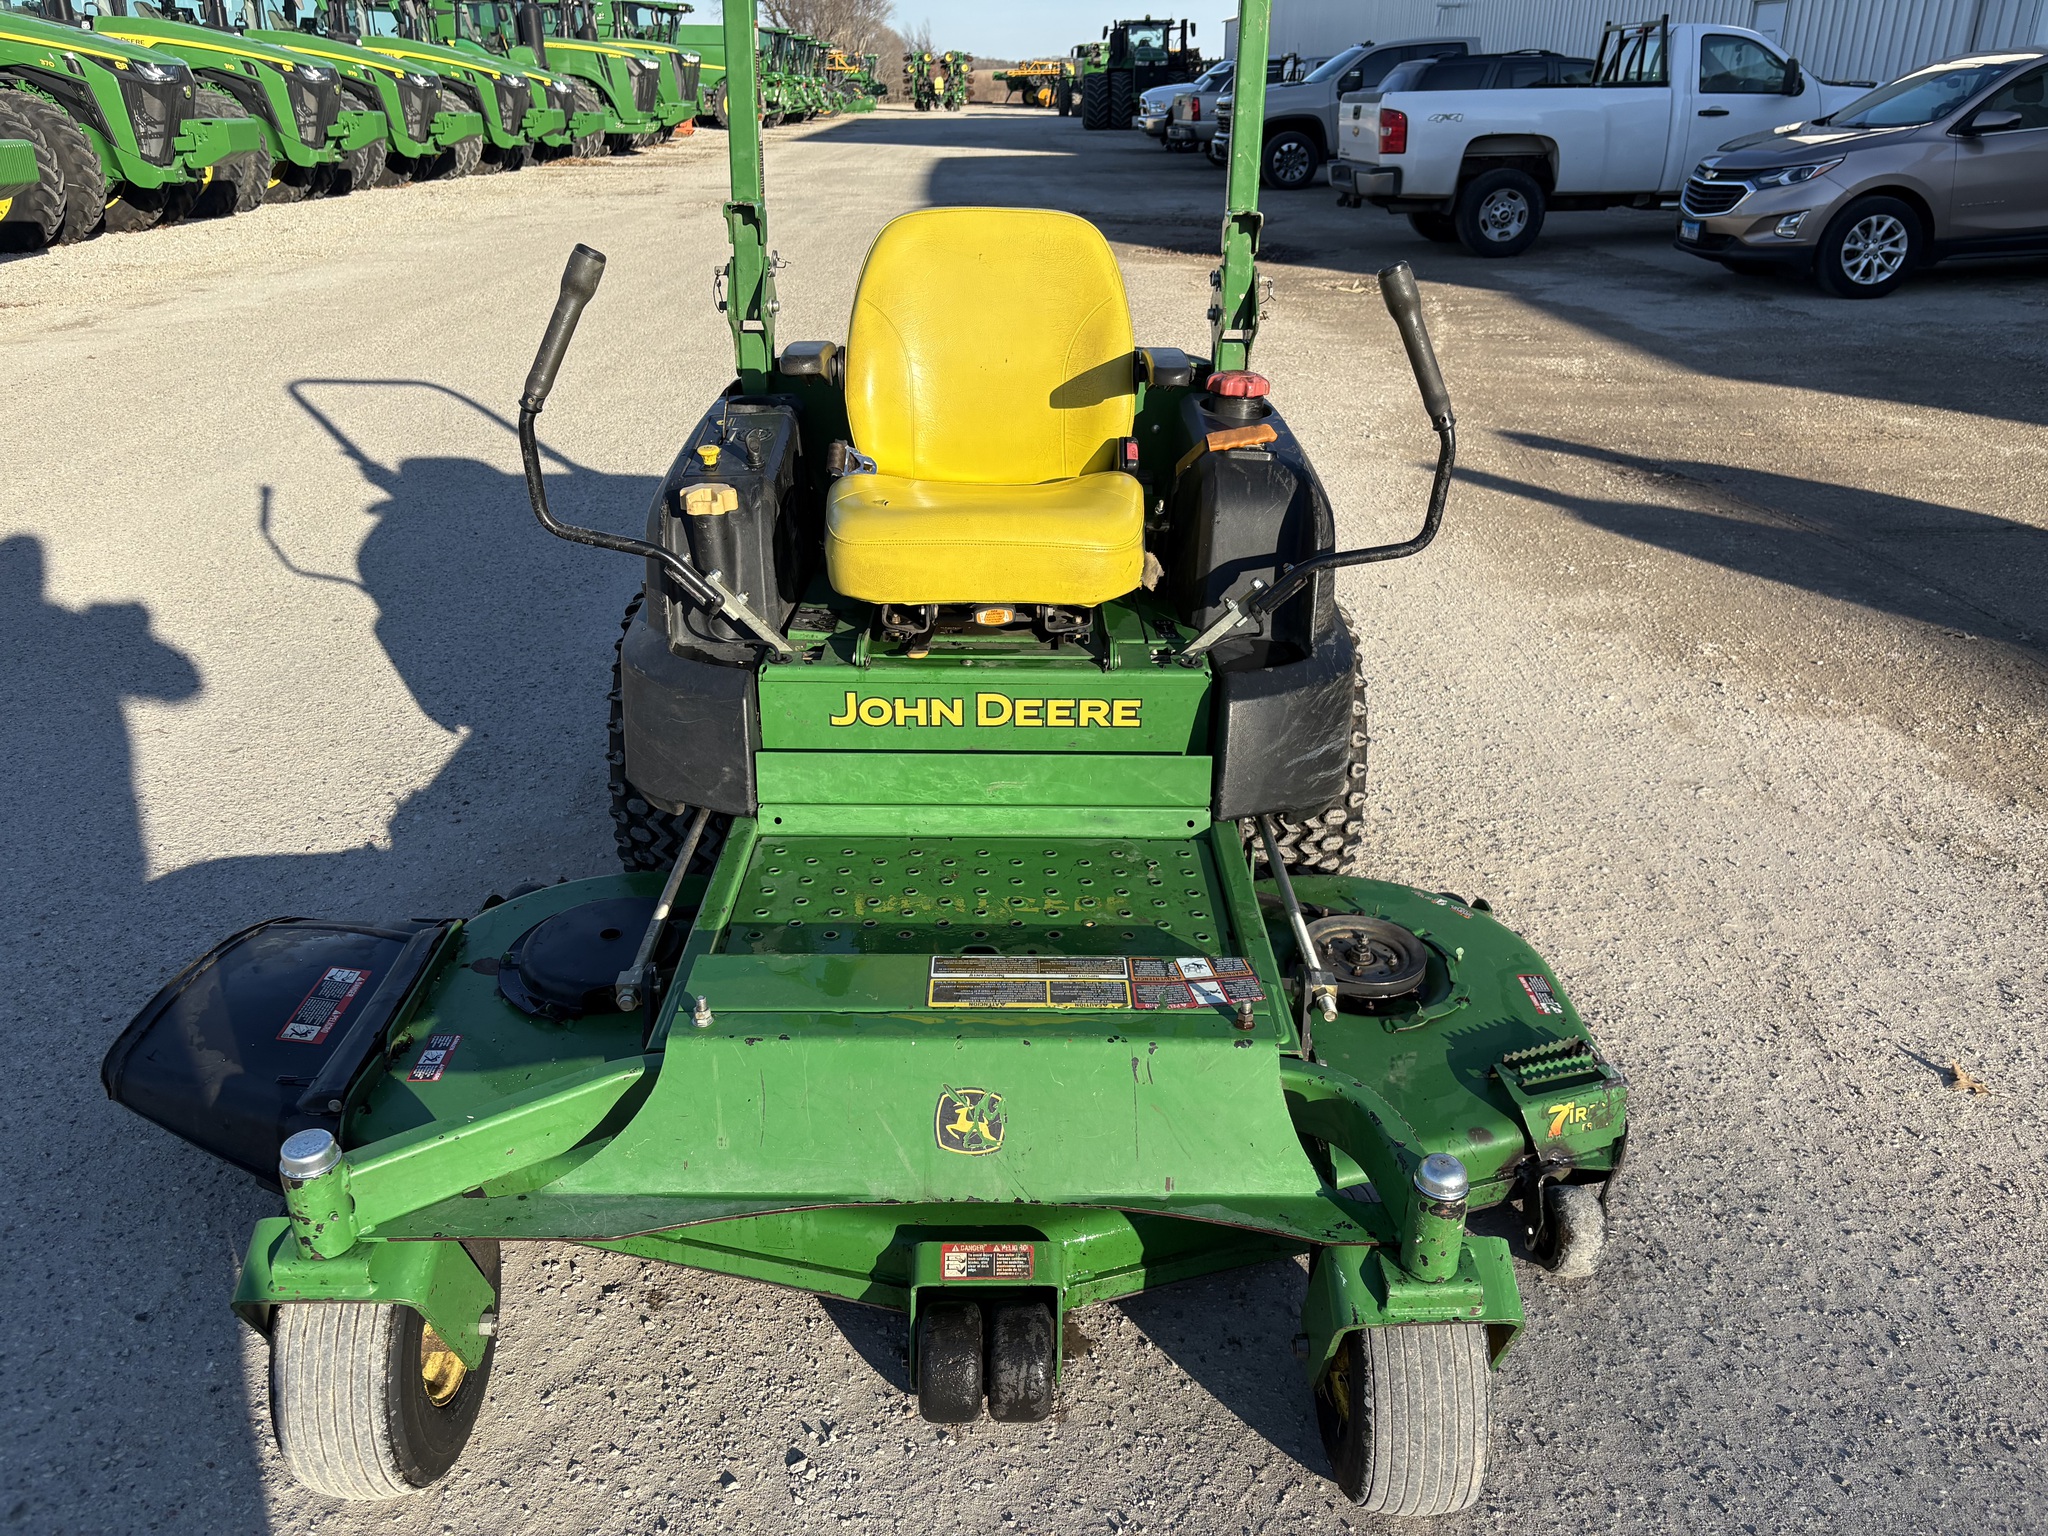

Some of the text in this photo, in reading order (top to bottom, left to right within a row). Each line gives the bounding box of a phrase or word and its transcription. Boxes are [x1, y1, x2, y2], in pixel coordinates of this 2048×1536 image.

[39, 58, 55, 68] 370
[114, 61, 129, 71] 8R
[829, 690, 1143, 729] JOHN DEERE
[960, 1244, 984, 1252] DANGER
